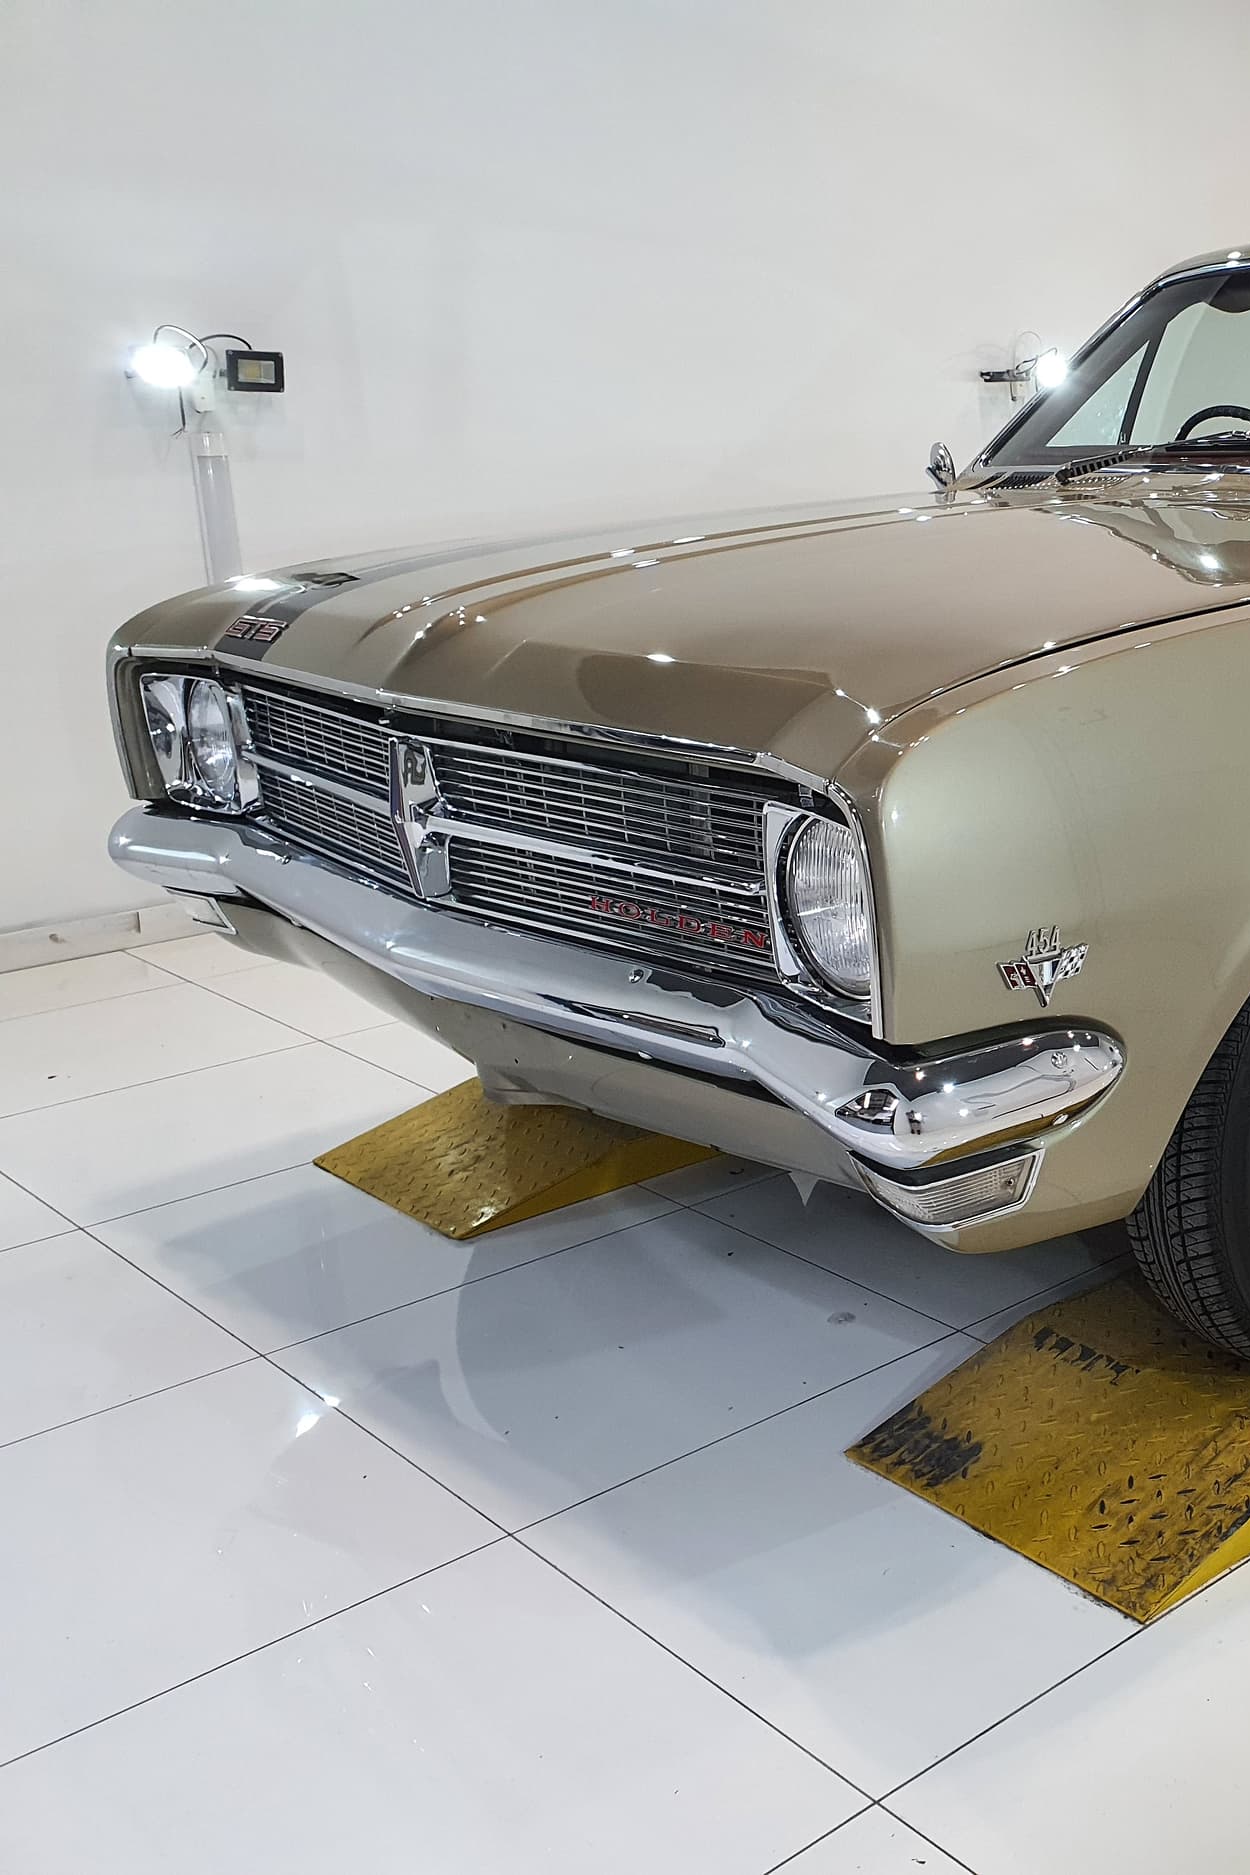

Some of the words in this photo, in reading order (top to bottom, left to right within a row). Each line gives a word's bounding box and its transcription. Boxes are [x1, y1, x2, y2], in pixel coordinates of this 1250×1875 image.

[224, 616, 287, 642] GTS
[589, 896, 767, 949] HOLDEN
[1026, 926, 1061, 956] 454
